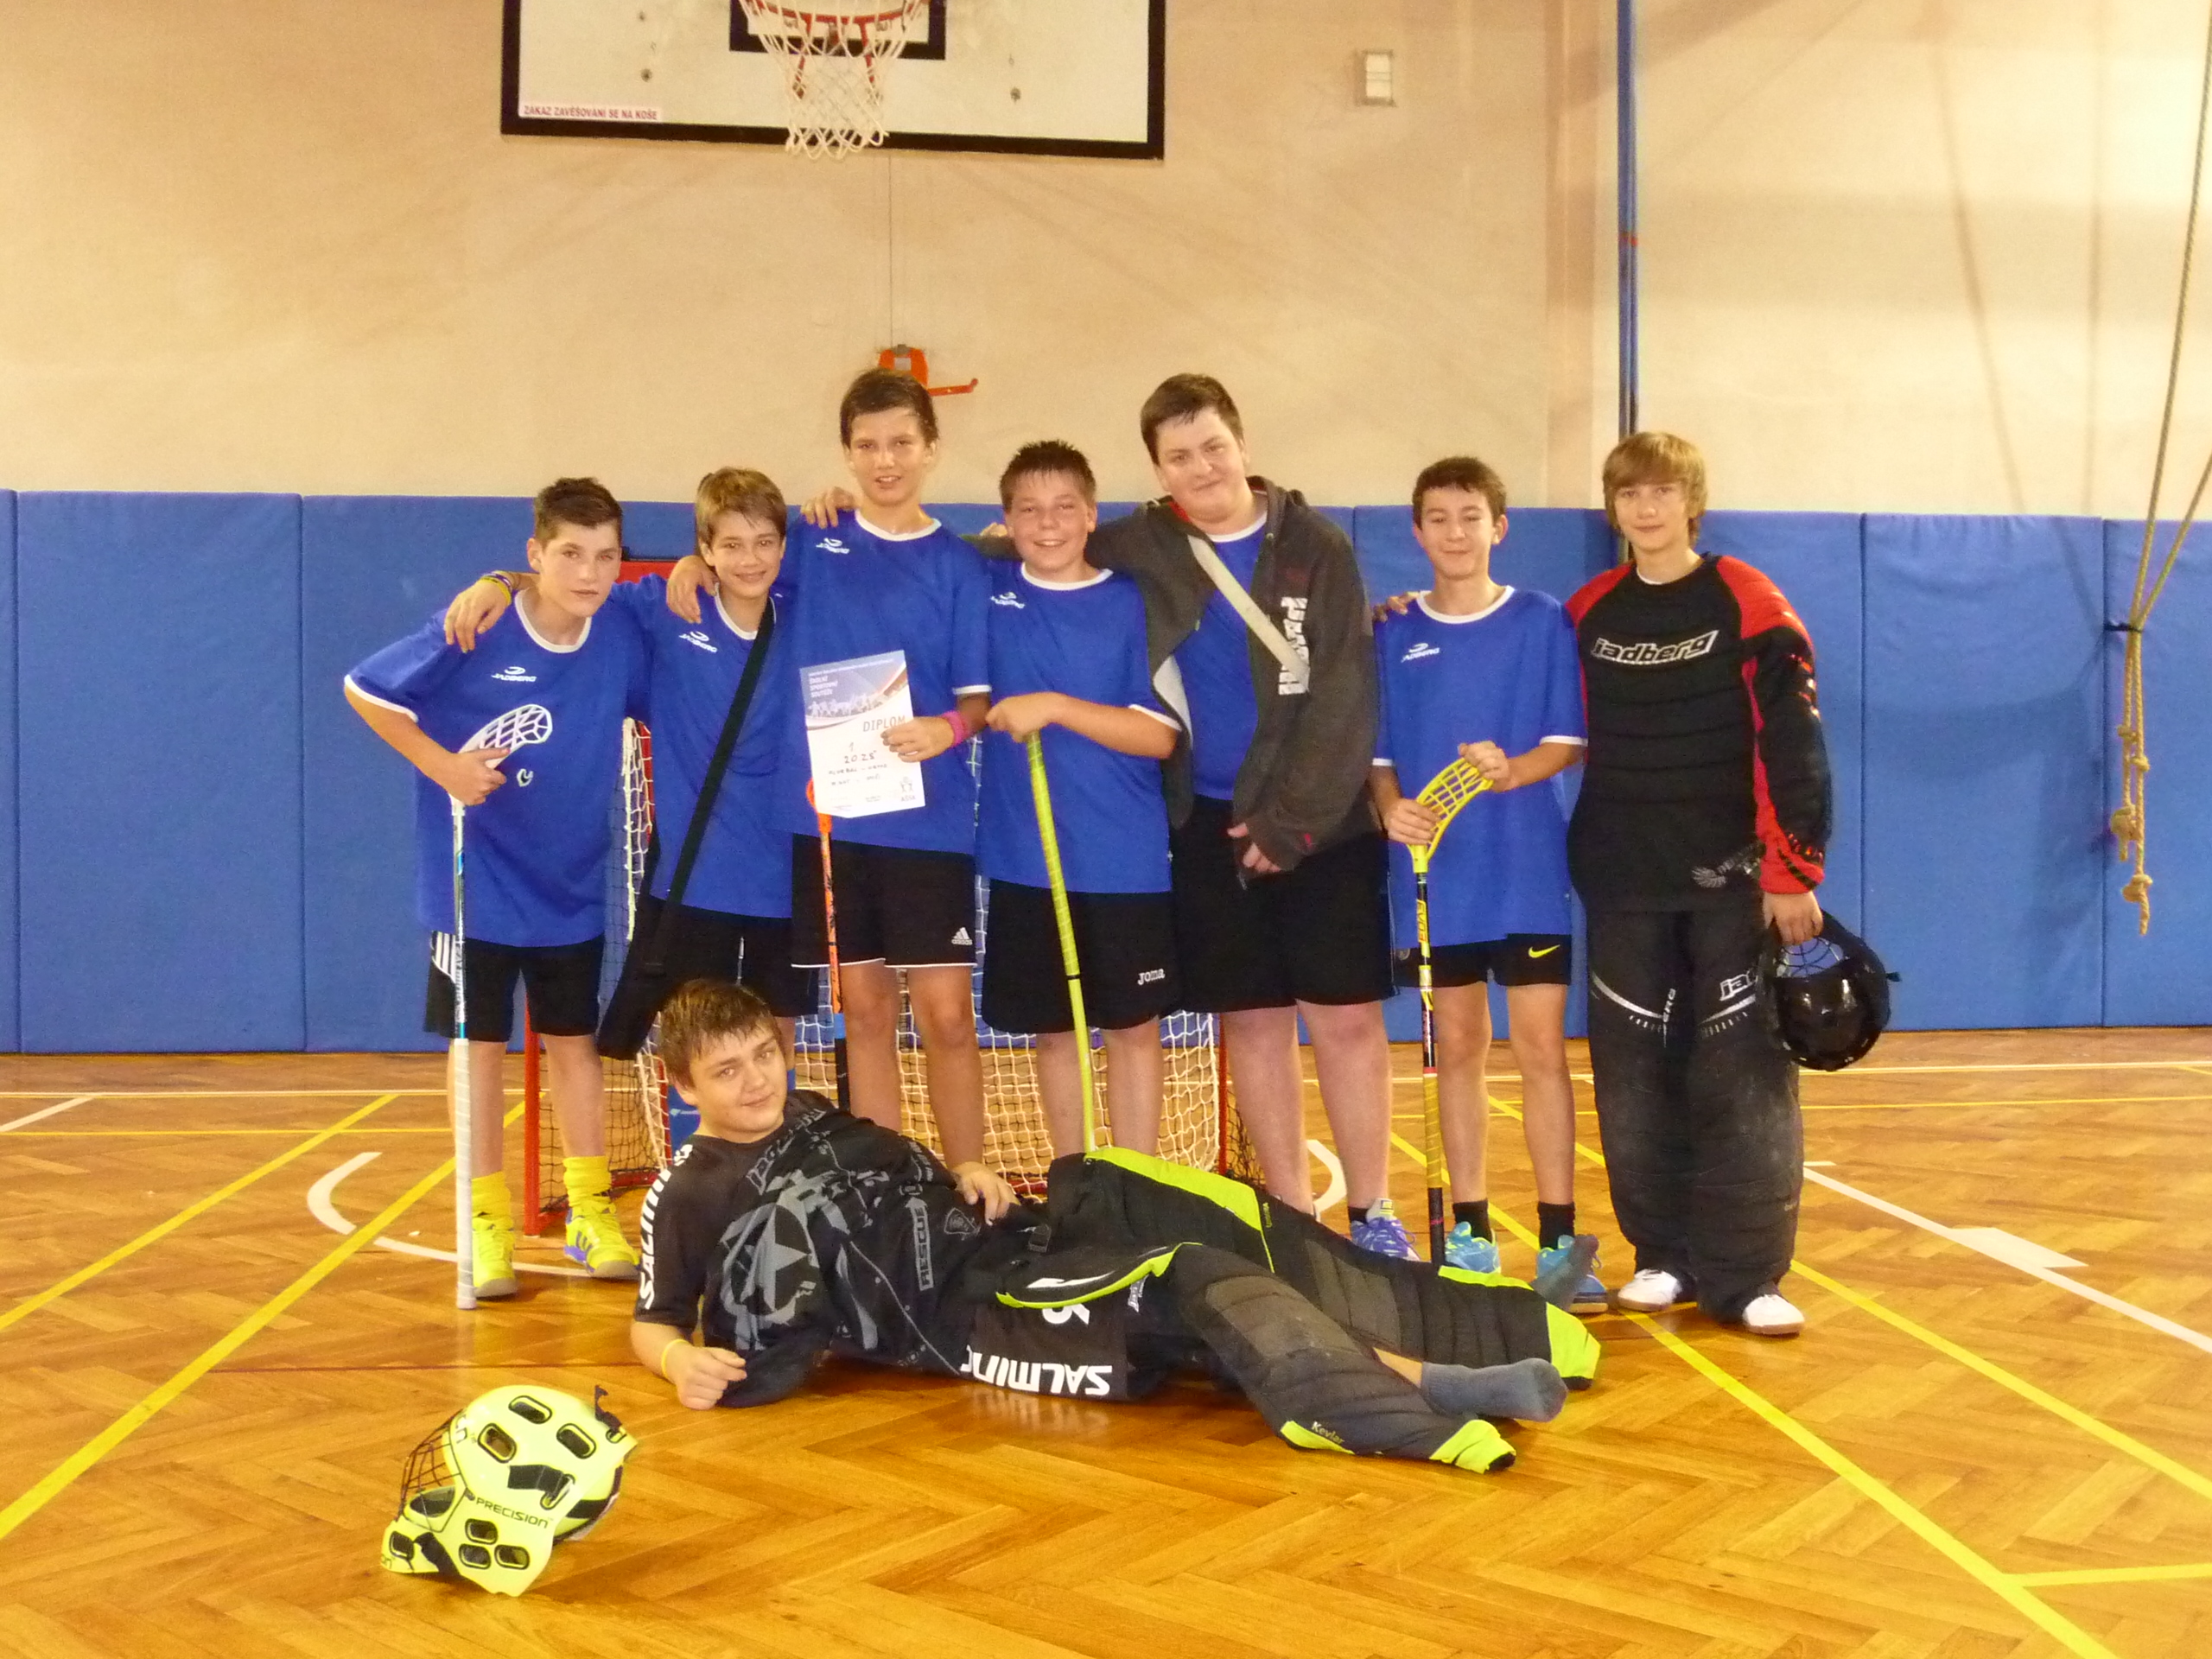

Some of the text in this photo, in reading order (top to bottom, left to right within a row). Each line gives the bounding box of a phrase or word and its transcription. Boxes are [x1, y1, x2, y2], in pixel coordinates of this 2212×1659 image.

[608, 108, 620, 119] SE
[621, 109, 633, 120] NA
[475, 1496, 550, 1529] PRECISION
